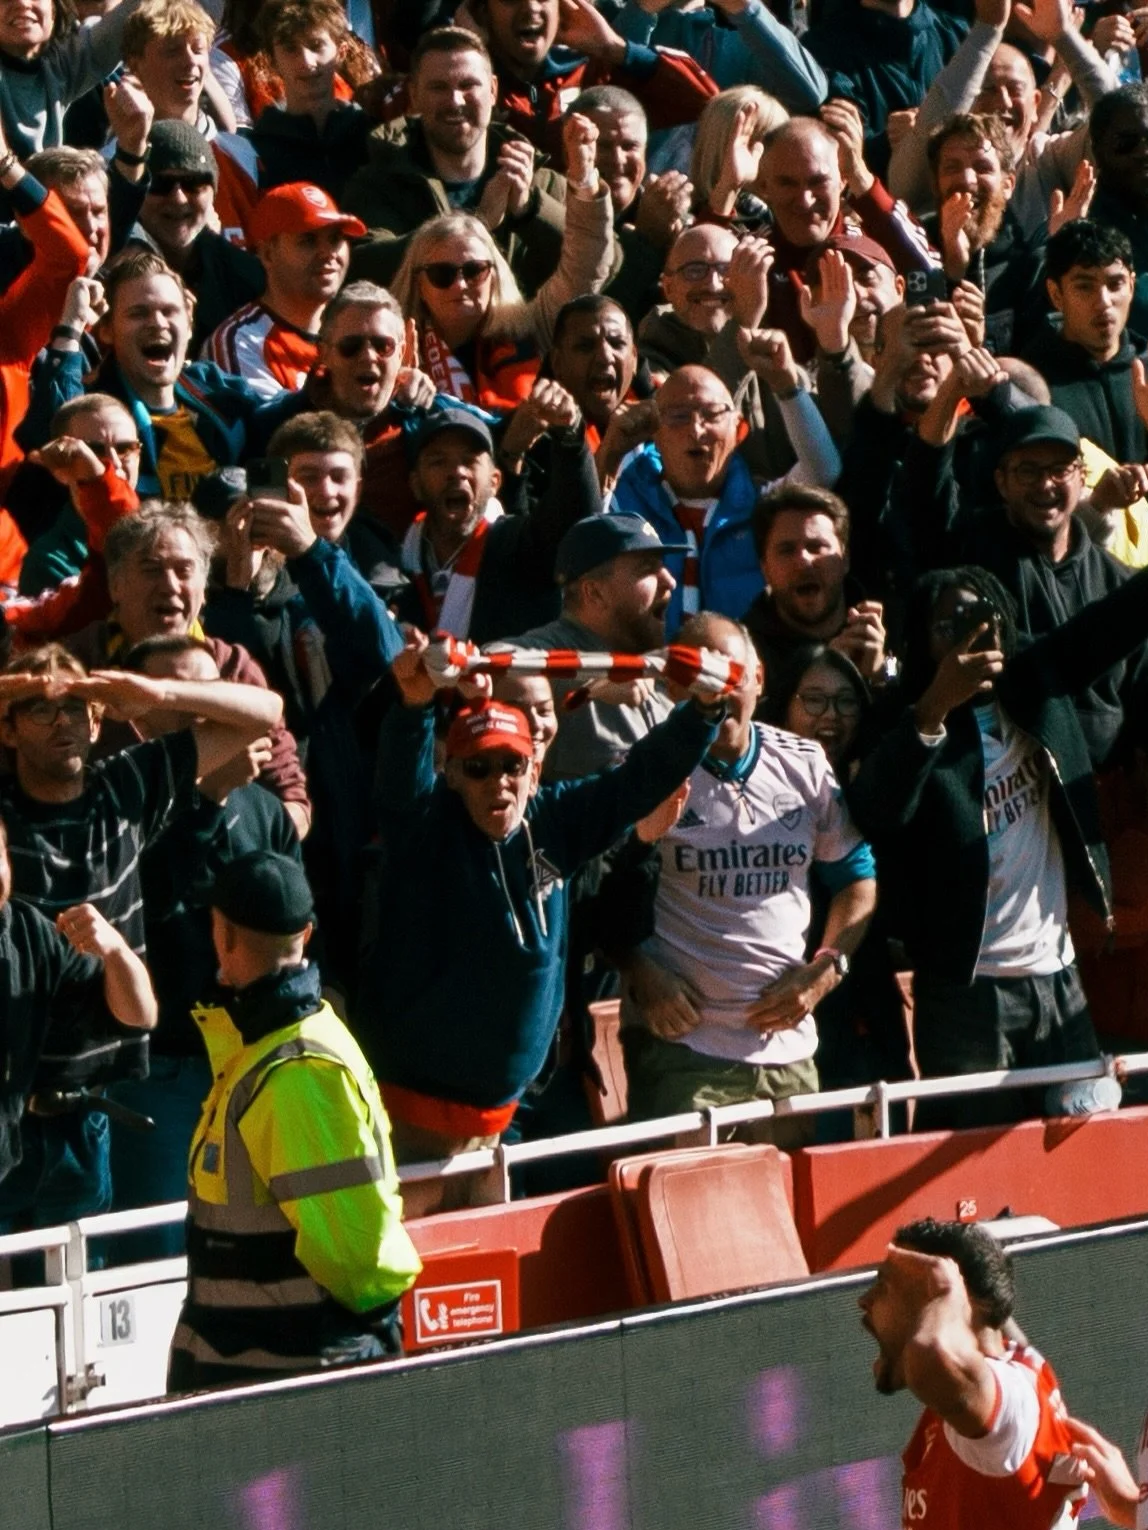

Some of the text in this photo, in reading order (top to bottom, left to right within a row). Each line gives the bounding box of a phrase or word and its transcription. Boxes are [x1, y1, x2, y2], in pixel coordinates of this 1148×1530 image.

[674, 839, 808, 873] Emirates
[698, 870, 790, 898] FLY BETTER
[959, 1199, 978, 1218] 25
[108, 1299, 131, 1341] 13
[449, 1303, 495, 1317] emergency
[452, 1315, 494, 1328] telephone
